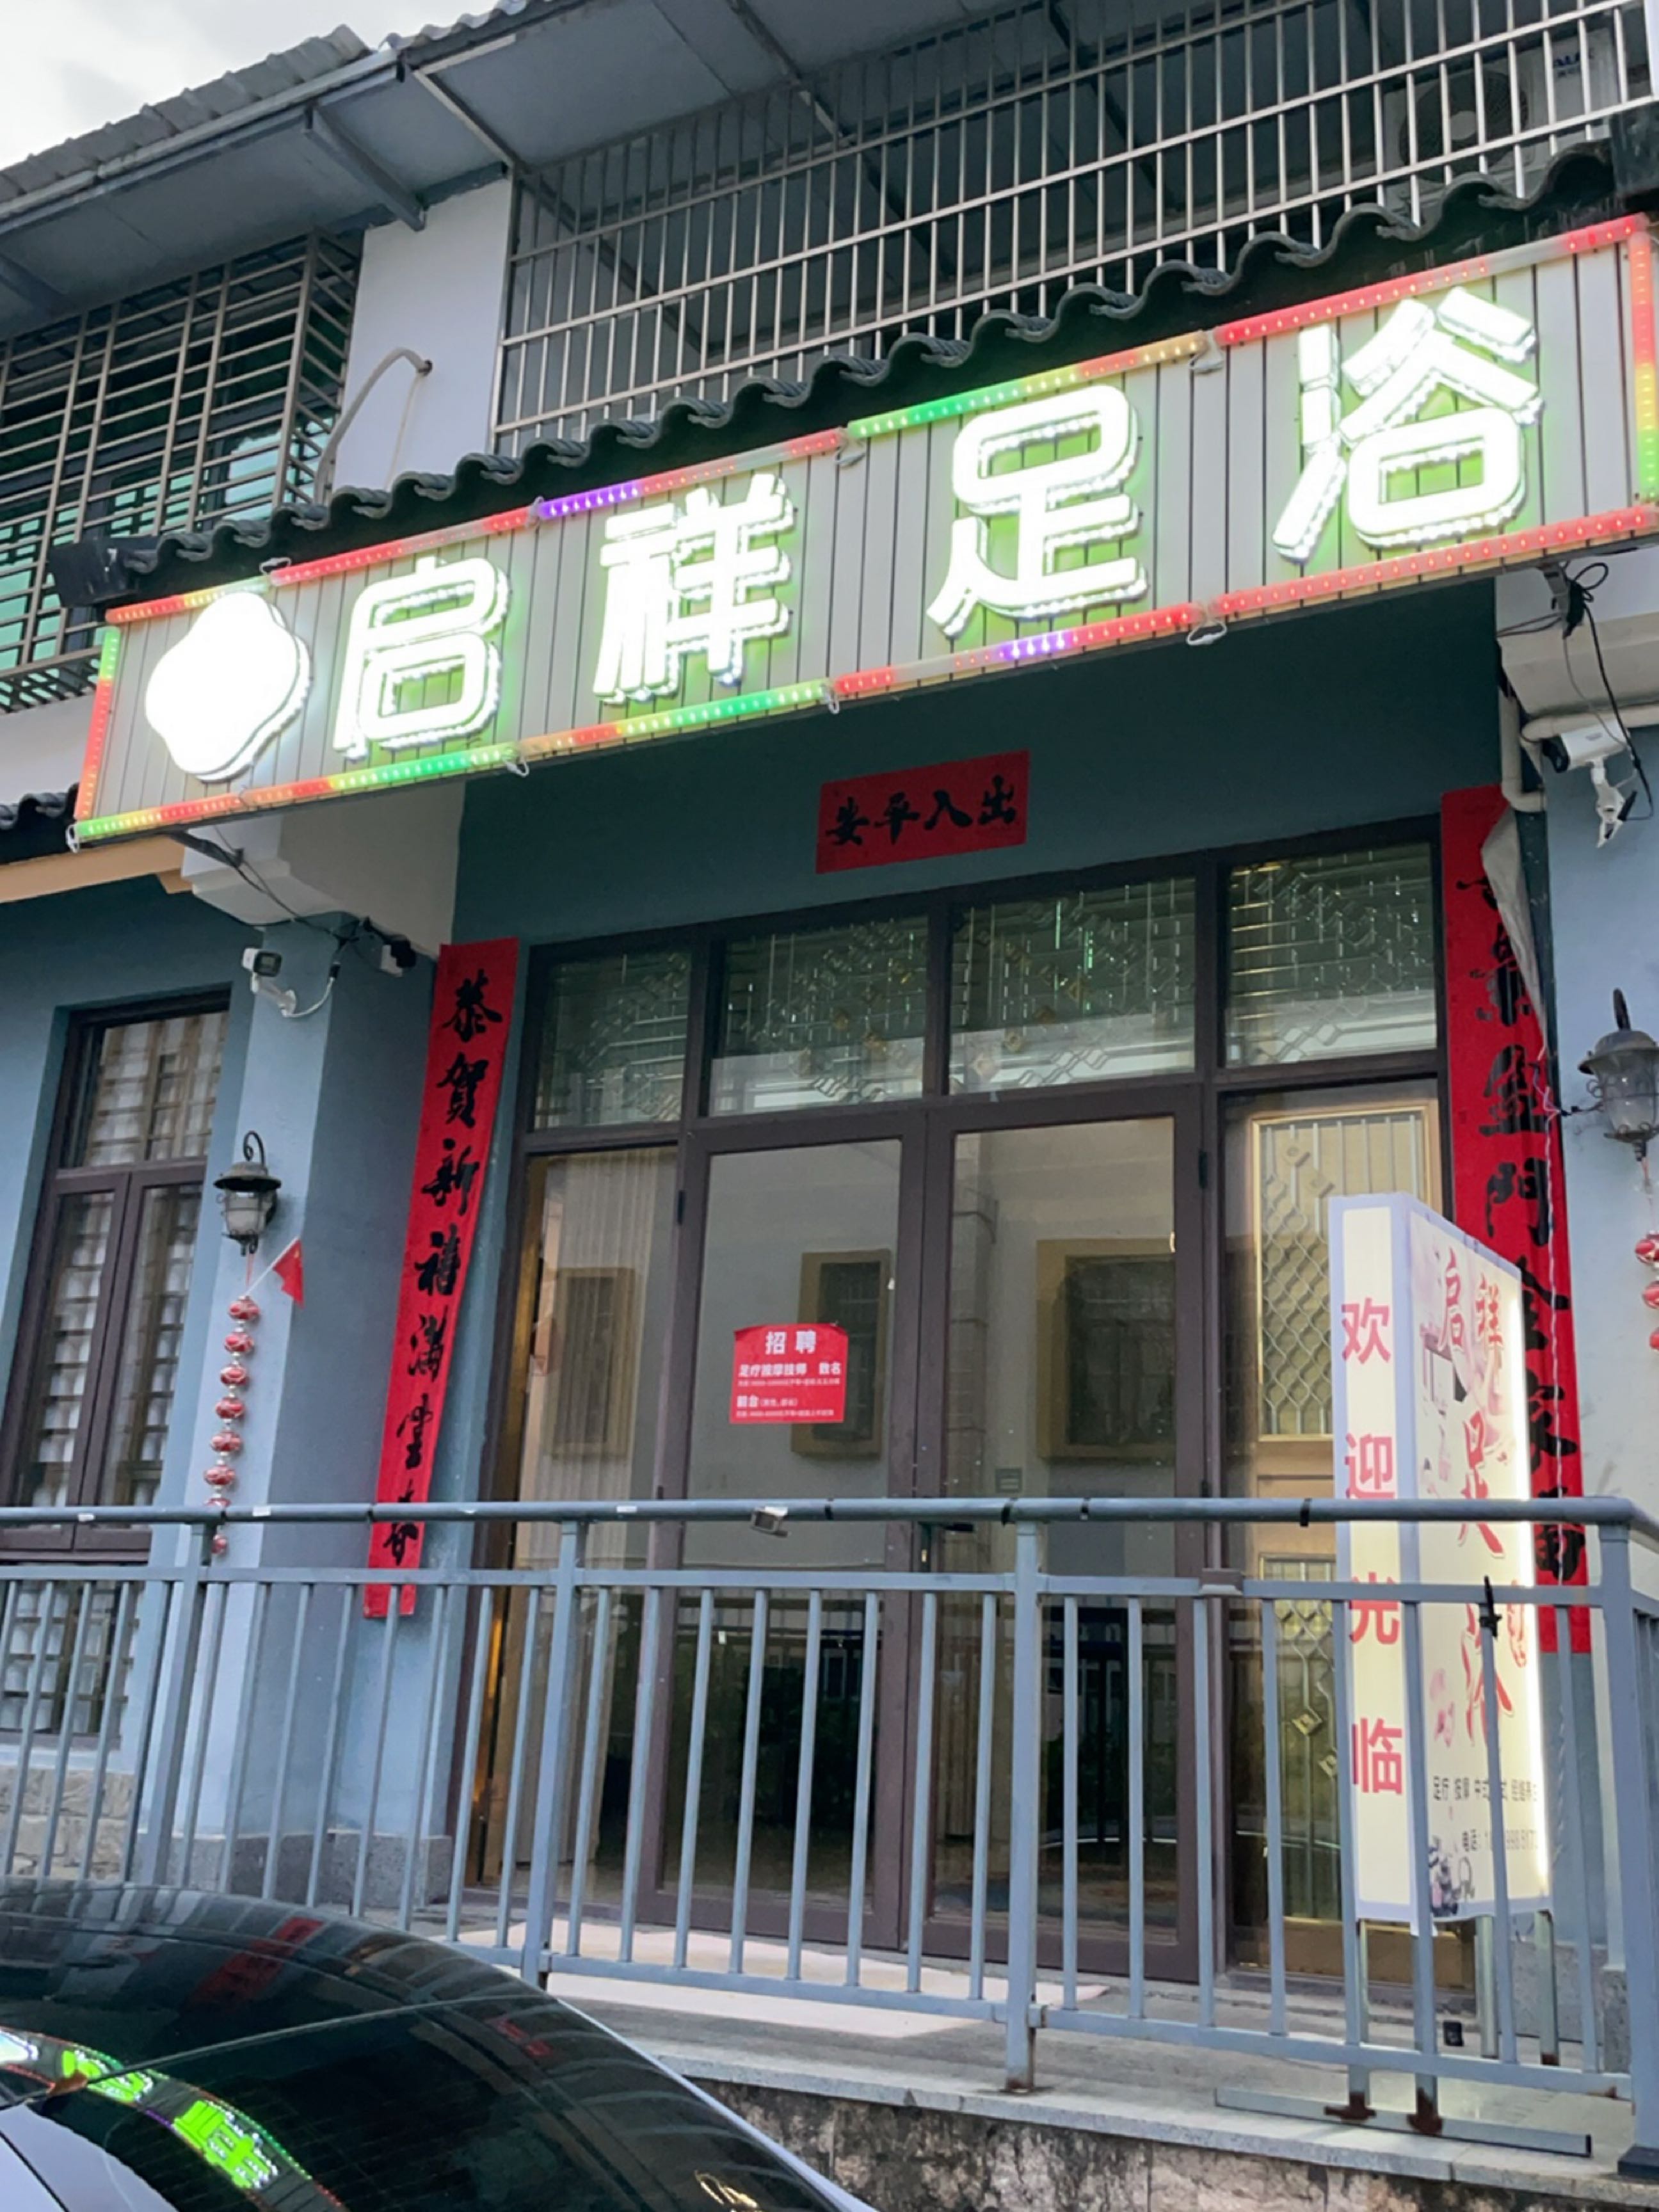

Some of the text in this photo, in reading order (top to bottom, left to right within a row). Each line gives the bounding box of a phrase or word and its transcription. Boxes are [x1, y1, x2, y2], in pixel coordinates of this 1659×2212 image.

[332, 285, 1543, 758] 启祥足浴
[765, 1329, 816, 1354] 招聘
[1341, 1297, 1403, 1794] 欢迎光临
